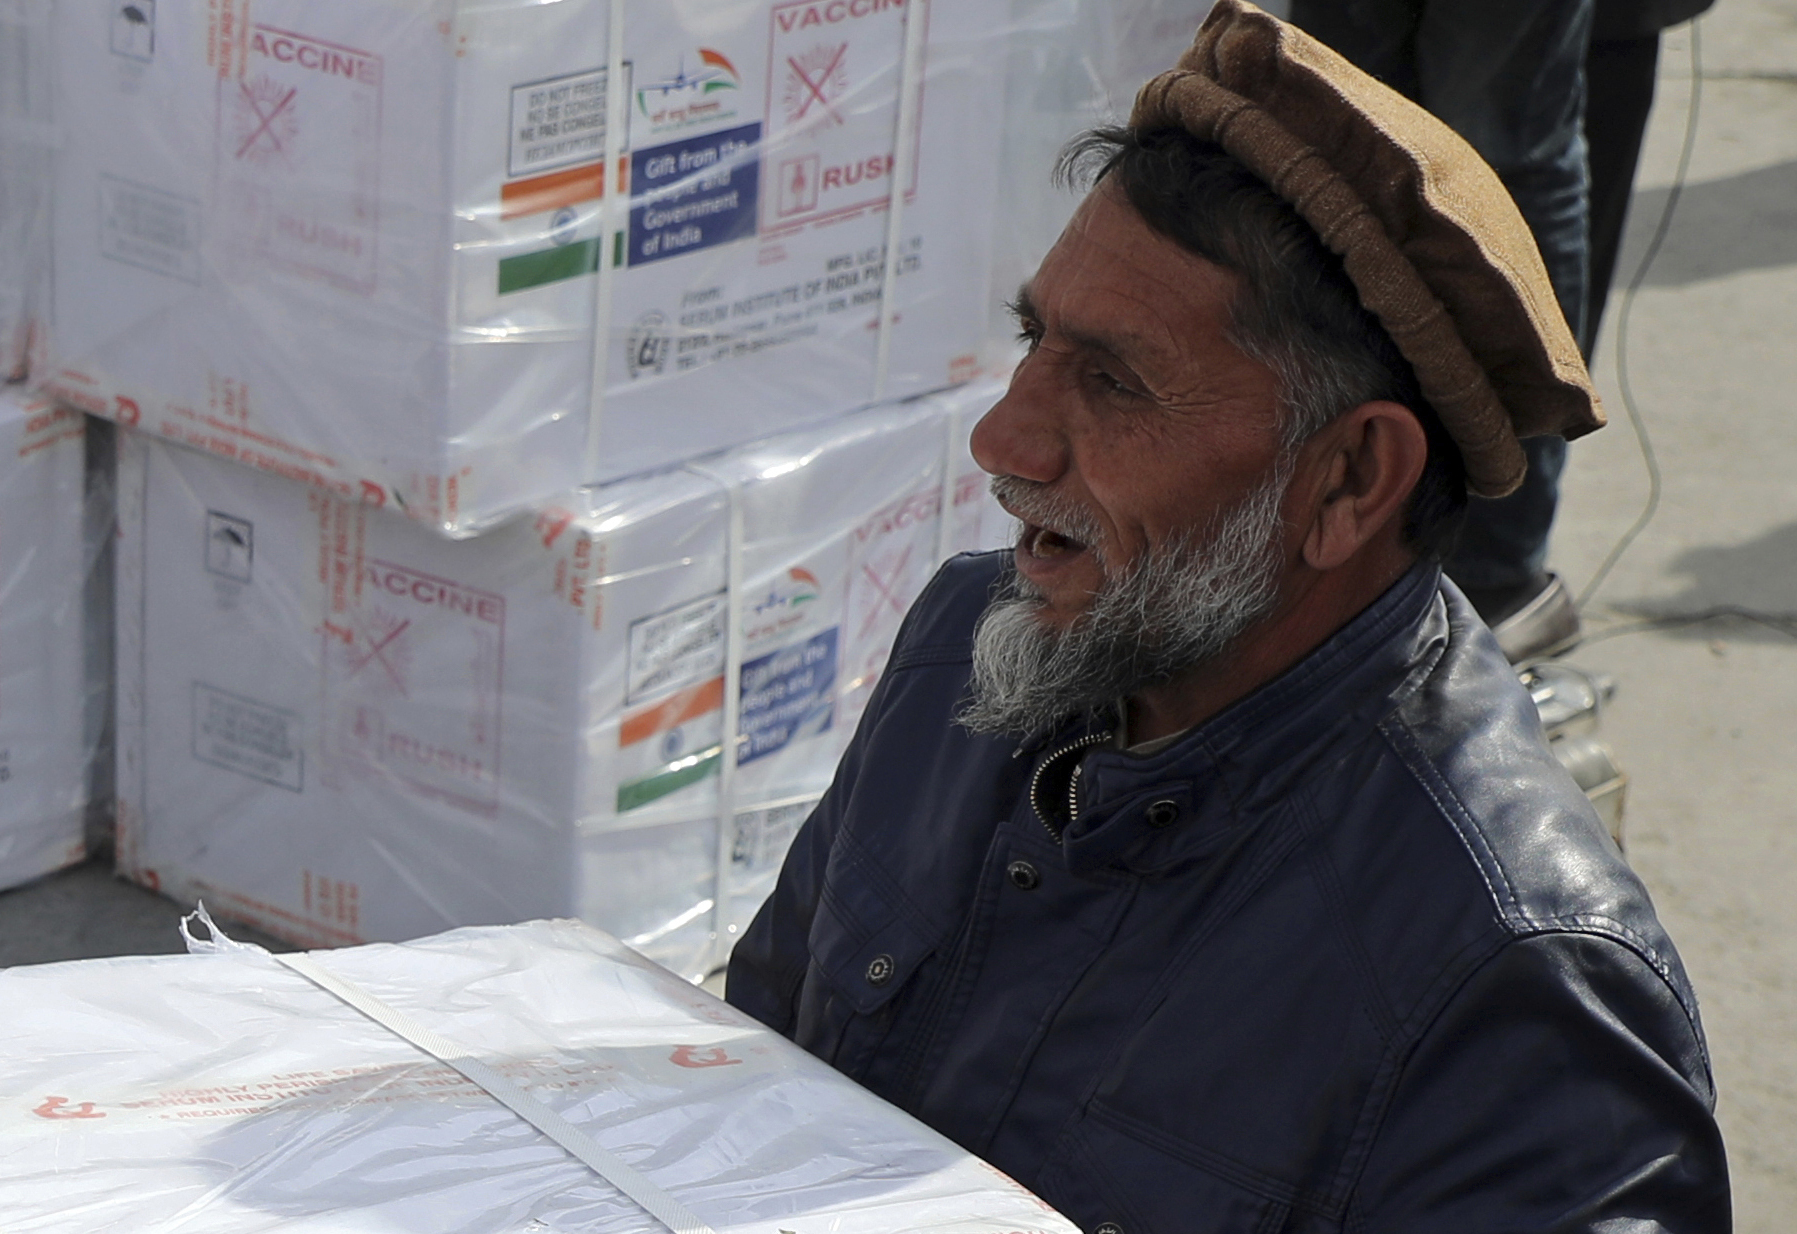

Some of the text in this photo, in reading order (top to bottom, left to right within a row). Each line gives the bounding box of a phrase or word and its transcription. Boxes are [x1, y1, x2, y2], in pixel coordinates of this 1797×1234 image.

[777, 0, 903, 32] VACCIN
[252, 33, 379, 86] ACCINE
[645, 154, 676, 179] Gift
[678, 146, 717, 172] from
[643, 189, 739, 231] Government
[641, 225, 703, 255] of India
